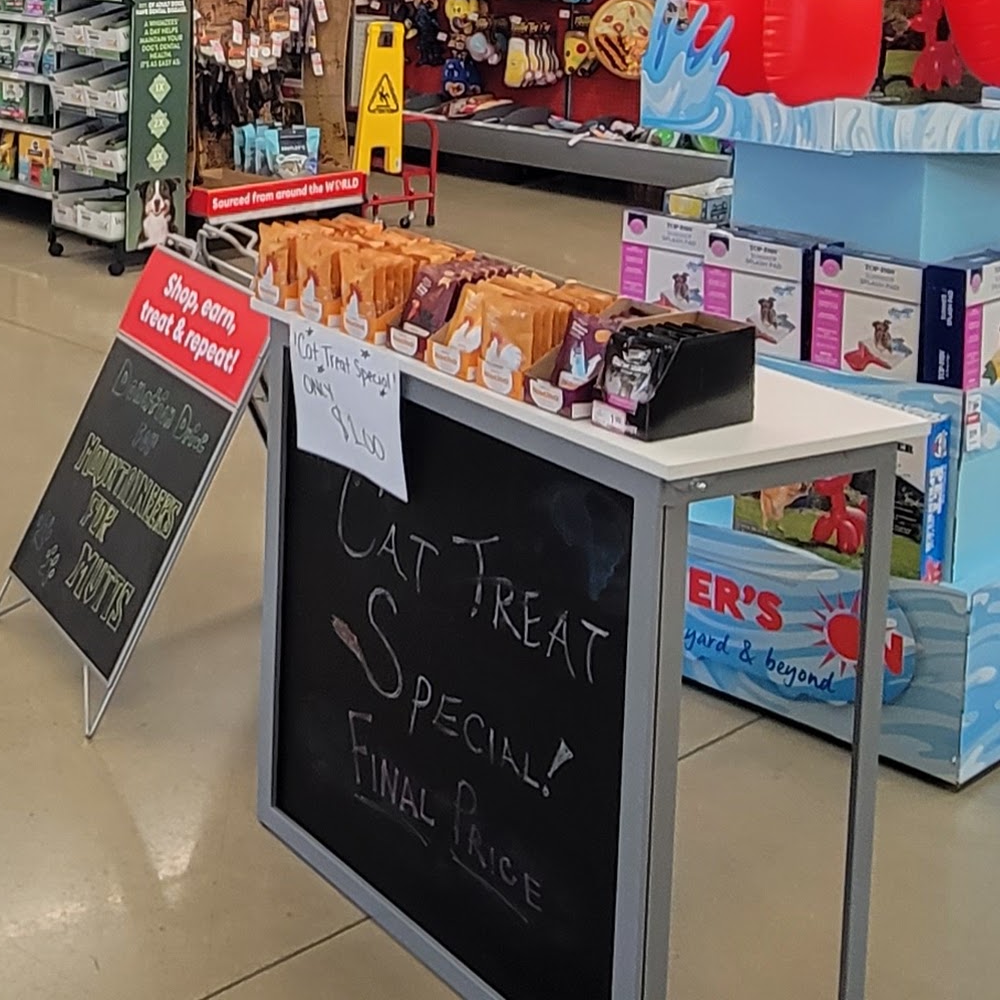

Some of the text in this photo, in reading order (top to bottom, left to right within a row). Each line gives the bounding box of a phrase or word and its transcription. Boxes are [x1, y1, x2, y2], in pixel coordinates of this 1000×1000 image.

[212, 194, 250, 211] Sourced
[251, 190, 274, 206] from
[275, 184, 307, 201] around
[308, 182, 324, 196] the
[139, 299, 240, 375] treat & repeat!
[163, 272, 237, 336] Shop, earn,
[321, 345, 351, 375] Treat
[65, 542, 135, 632] MUTTS
[338, 470, 609, 684] CAT TREAT
[688, 566, 784, 631] ER'S
[684, 631, 836, 693] yard & beyond
[348, 709, 435, 827] FINAL
[453, 779, 542, 912] PRICE
